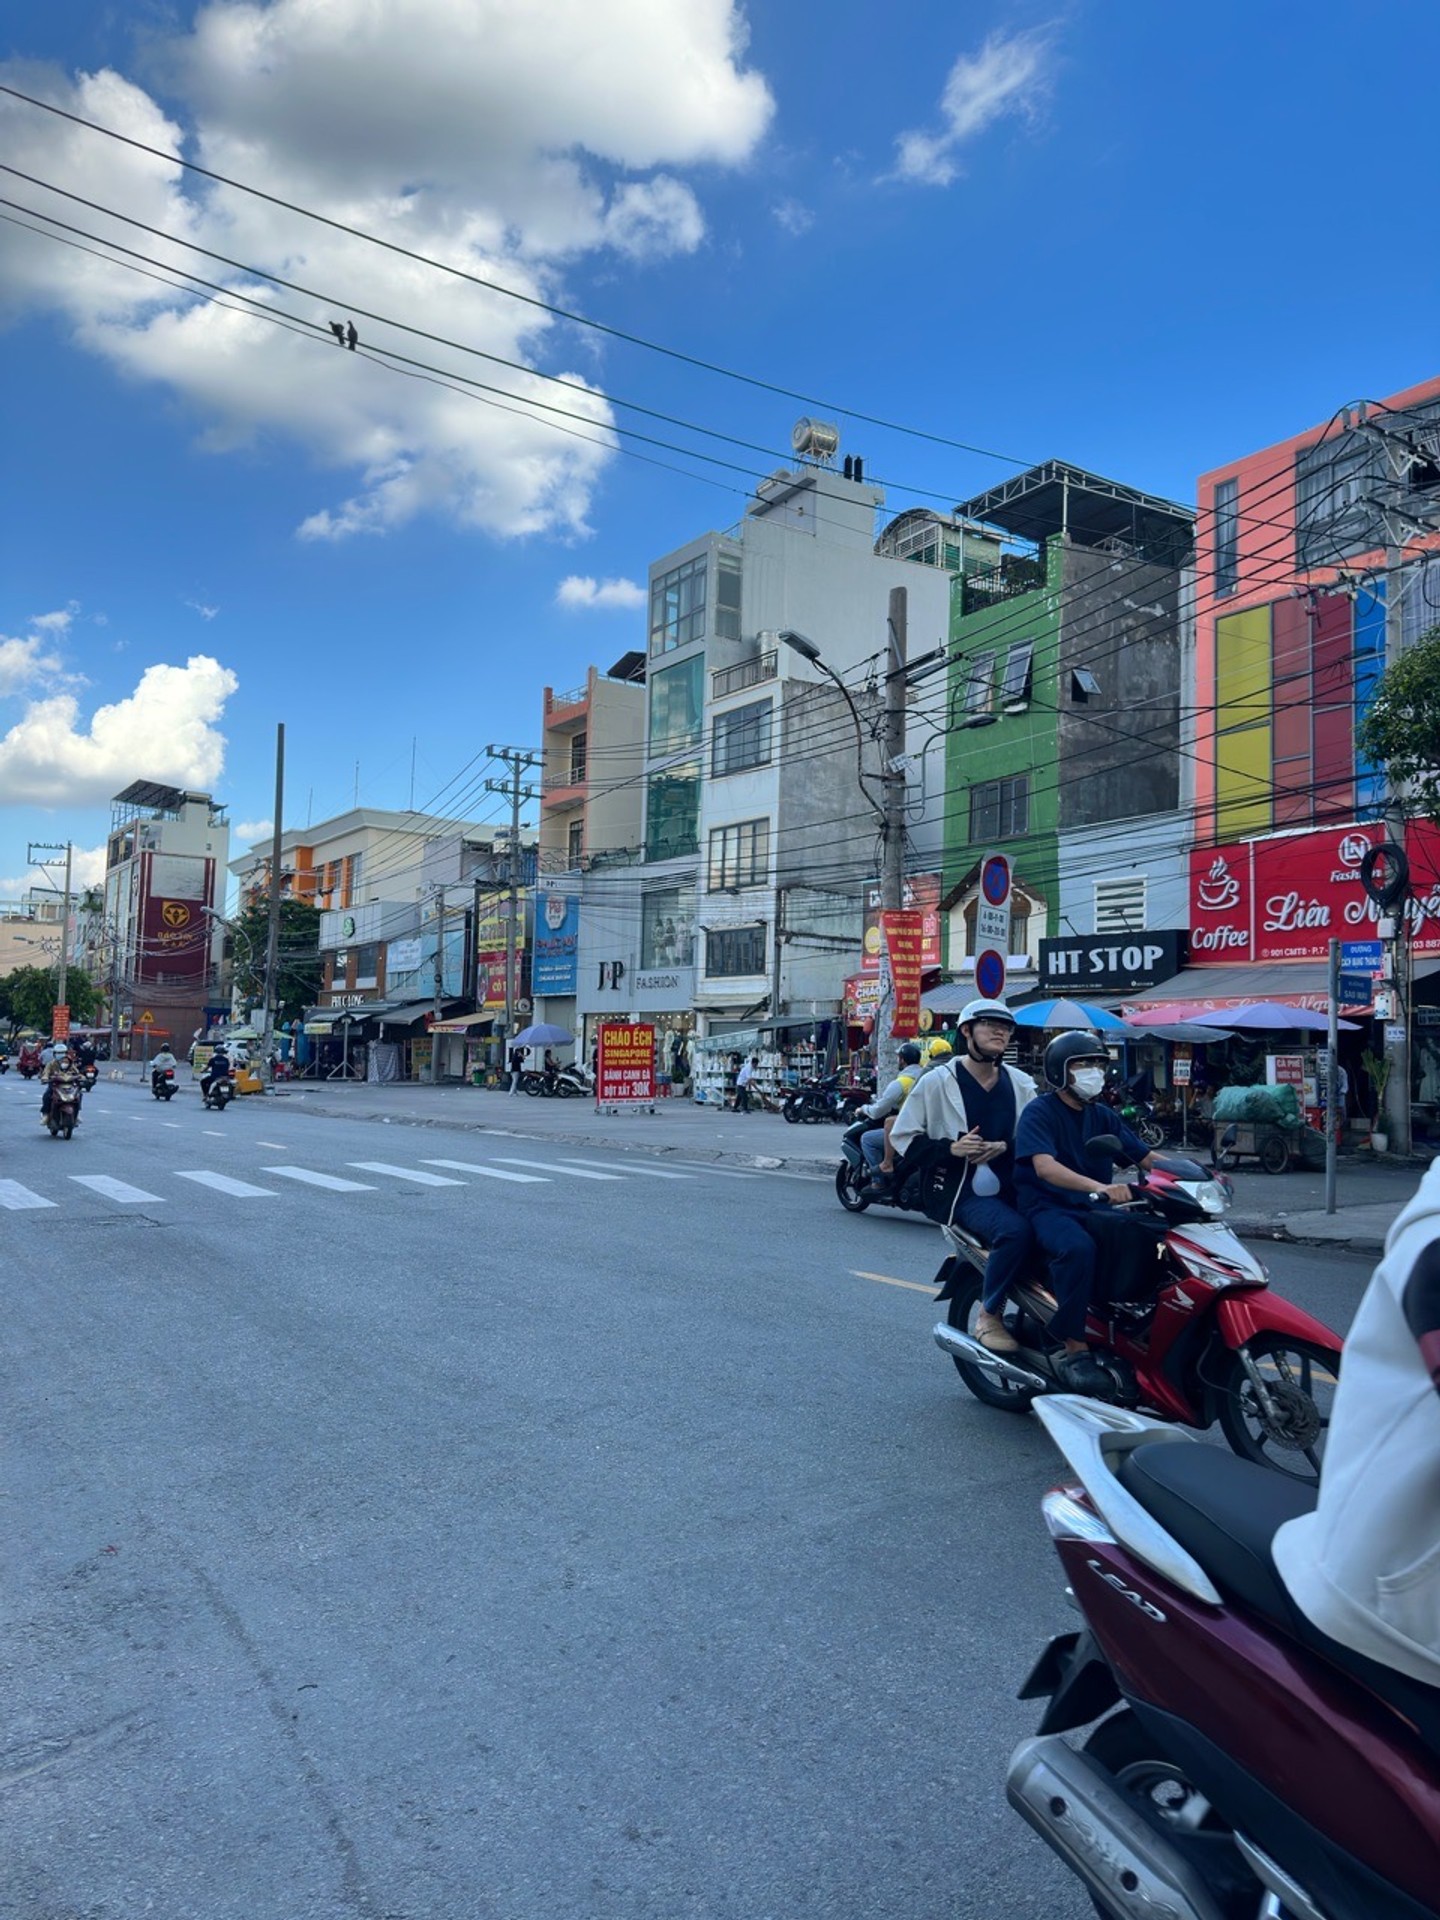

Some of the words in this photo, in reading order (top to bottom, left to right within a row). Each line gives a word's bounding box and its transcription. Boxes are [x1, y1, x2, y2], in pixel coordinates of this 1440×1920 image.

[1263, 891, 1331, 931] Liên
[1191, 925, 1249, 951] Coffee
[1048, 950, 1083, 975] HT
[1088, 945, 1164, 974] STOP
[1270, 949, 1283, 957] 901
[636, 975, 679, 990] FASHION
[603, 1028, 631, 1047] CHÁO
[632, 1026, 653, 1046] ẾCH
[604, 1049, 651, 1058] SINGAPORE
[604, 1068, 622, 1081] BÁNH
[623, 1070, 641, 1080] CANH
[642, 1068, 651, 1080] GÀ
[631, 1081, 651, 1097] 30K
[1087, 1560, 1167, 1622] LEAD
